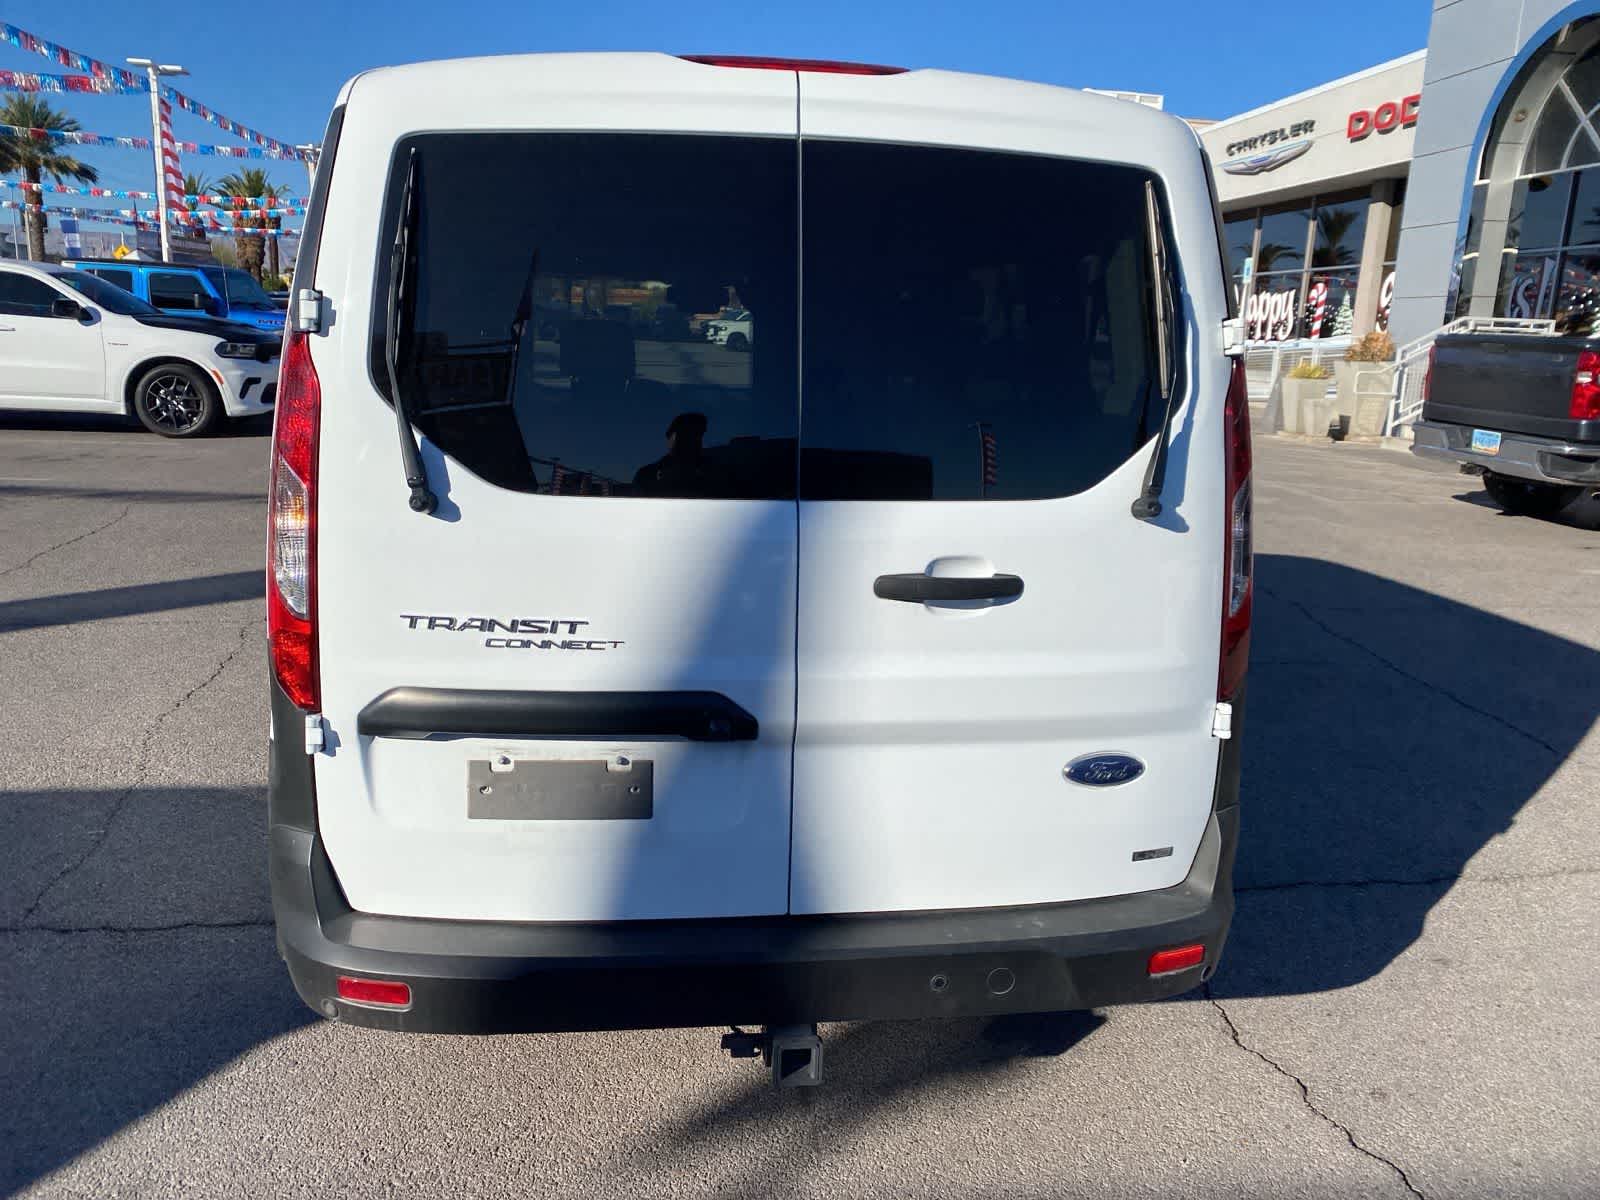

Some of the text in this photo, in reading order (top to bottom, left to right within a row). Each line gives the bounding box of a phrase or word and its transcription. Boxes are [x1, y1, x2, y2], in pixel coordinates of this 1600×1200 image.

[1226, 119, 1316, 157] CHRYSLER
[399, 614, 590, 635] TRANSIT
[484, 638, 625, 651] CONNECT
[1084, 761, 1128, 780] Ford
